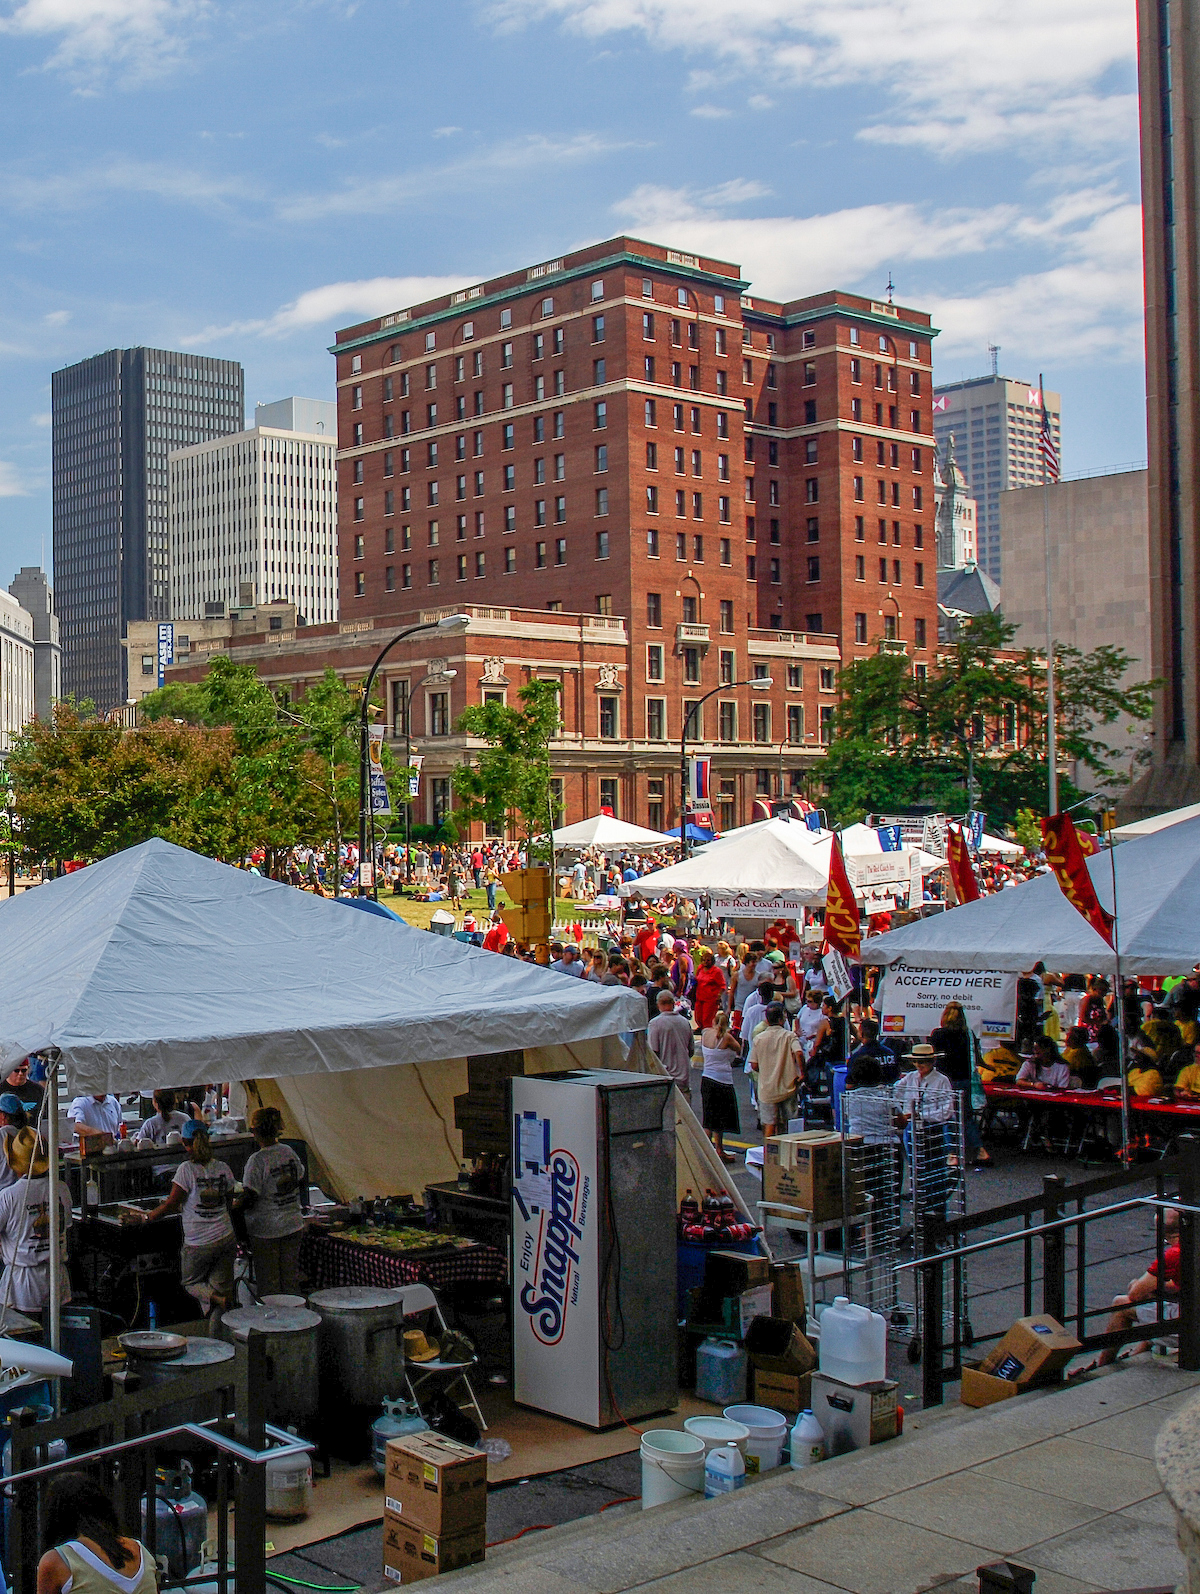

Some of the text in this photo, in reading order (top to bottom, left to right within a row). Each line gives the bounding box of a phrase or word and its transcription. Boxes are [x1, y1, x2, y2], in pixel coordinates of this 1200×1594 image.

[692, 800, 710, 809] Russia
[715, 899, 798, 909] The Red Coach Inn
[894, 976, 1002, 988] ACCEPTED HERE
[916, 992, 939, 1001] Sorry,
[952, 993, 973, 1001] debit
[905, 1001, 947, 1009] transaction
[986, 1025, 1007, 1033] VISA
[571, 1175, 590, 1306] Natural Beverages
[520, 1157, 582, 1337] Snapple
[520, 1230, 535, 1272] Enjoy
